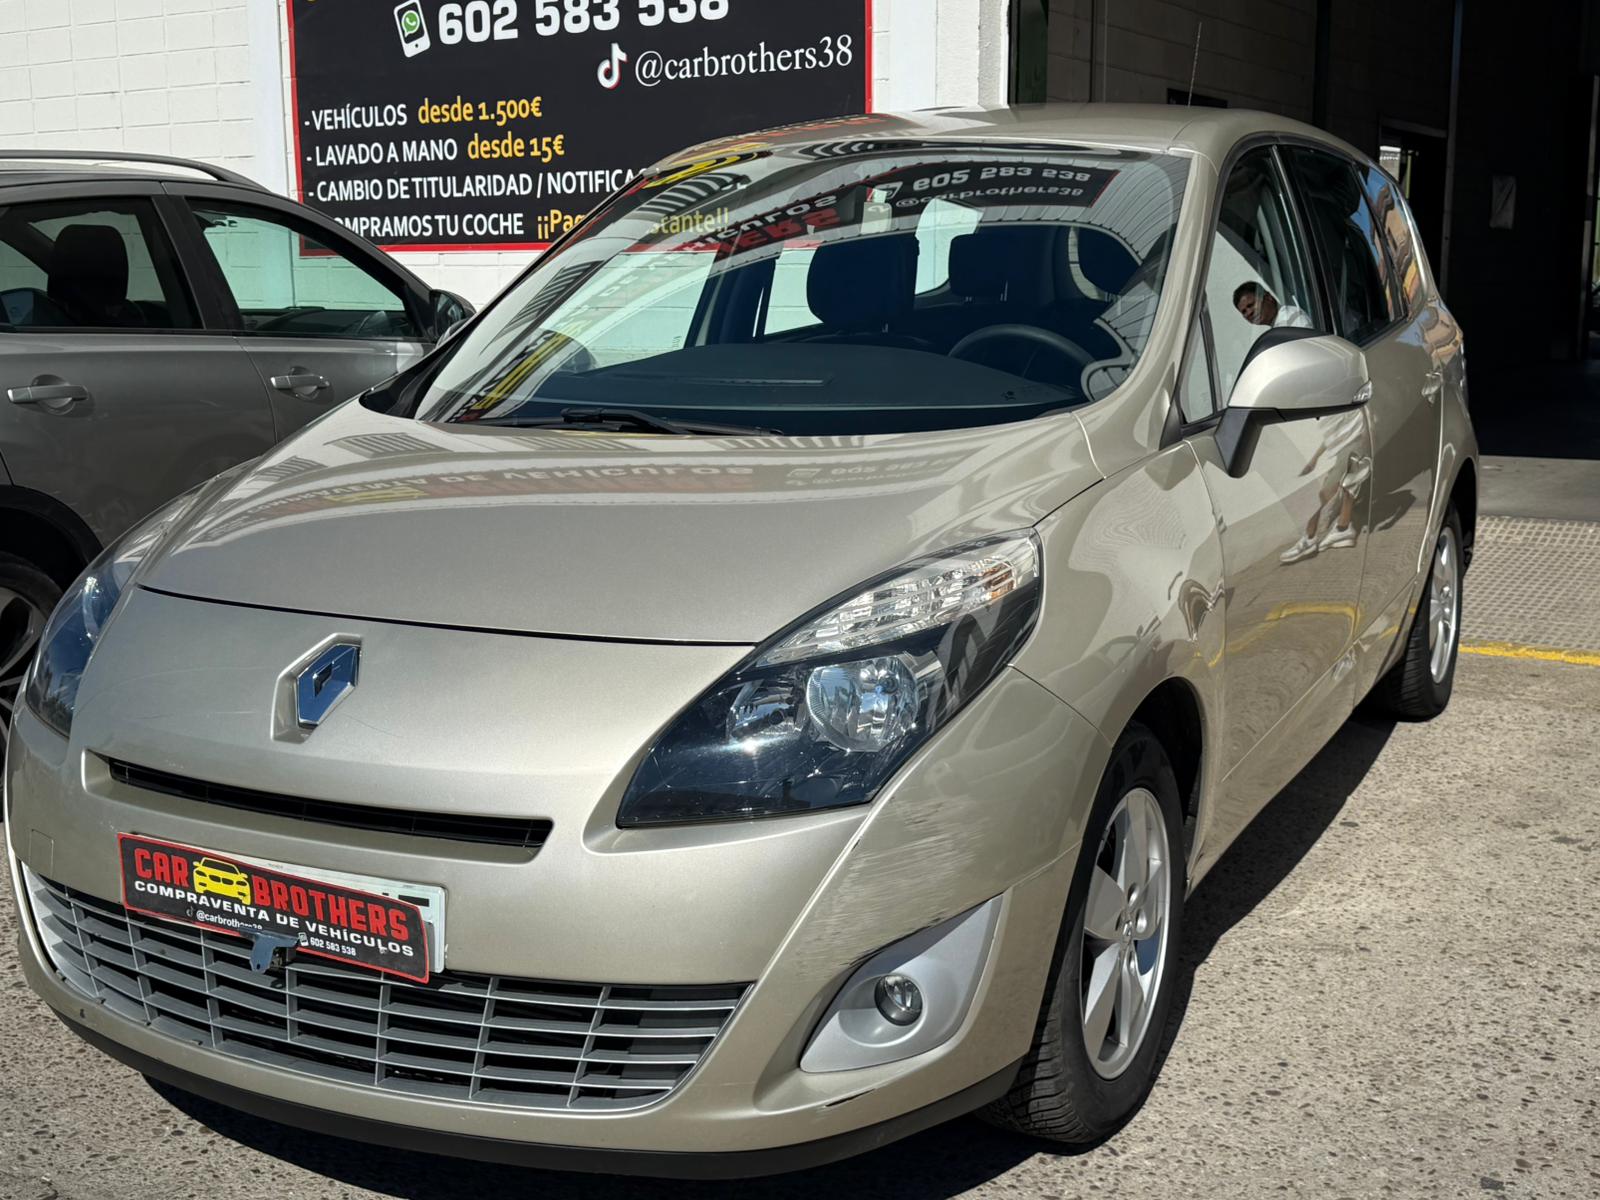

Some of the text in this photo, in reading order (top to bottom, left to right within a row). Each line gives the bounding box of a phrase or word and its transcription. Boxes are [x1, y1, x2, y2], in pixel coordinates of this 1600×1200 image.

[438, 0, 518, 45] 602
[535, 0, 620, 37] 583
[635, 34, 853, 87] @carbrothers38
[418, 95, 474, 124] desde
[478, 96, 543, 126] 1.500€
[387, 140, 398, 163] A
[403, 138, 457, 162] MANO
[467, 131, 525, 160] desde
[530, 134, 565, 164] 15€
[387, 176, 410, 199] DE
[411, 174, 532, 198] TITULARIDAD
[547, 168, 647, 194] NOTIFICA
[333, 214, 433, 237] MPRAMOS
[435, 214, 459, 236] TU
[463, 213, 525, 236] COCHE
[134, 847, 410, 941] CAR BROTHERS
[134, 879, 414, 957] COMPRAVENTA DE VEHÍCULOS
[309, 936, 357, 956] 602 583 538
